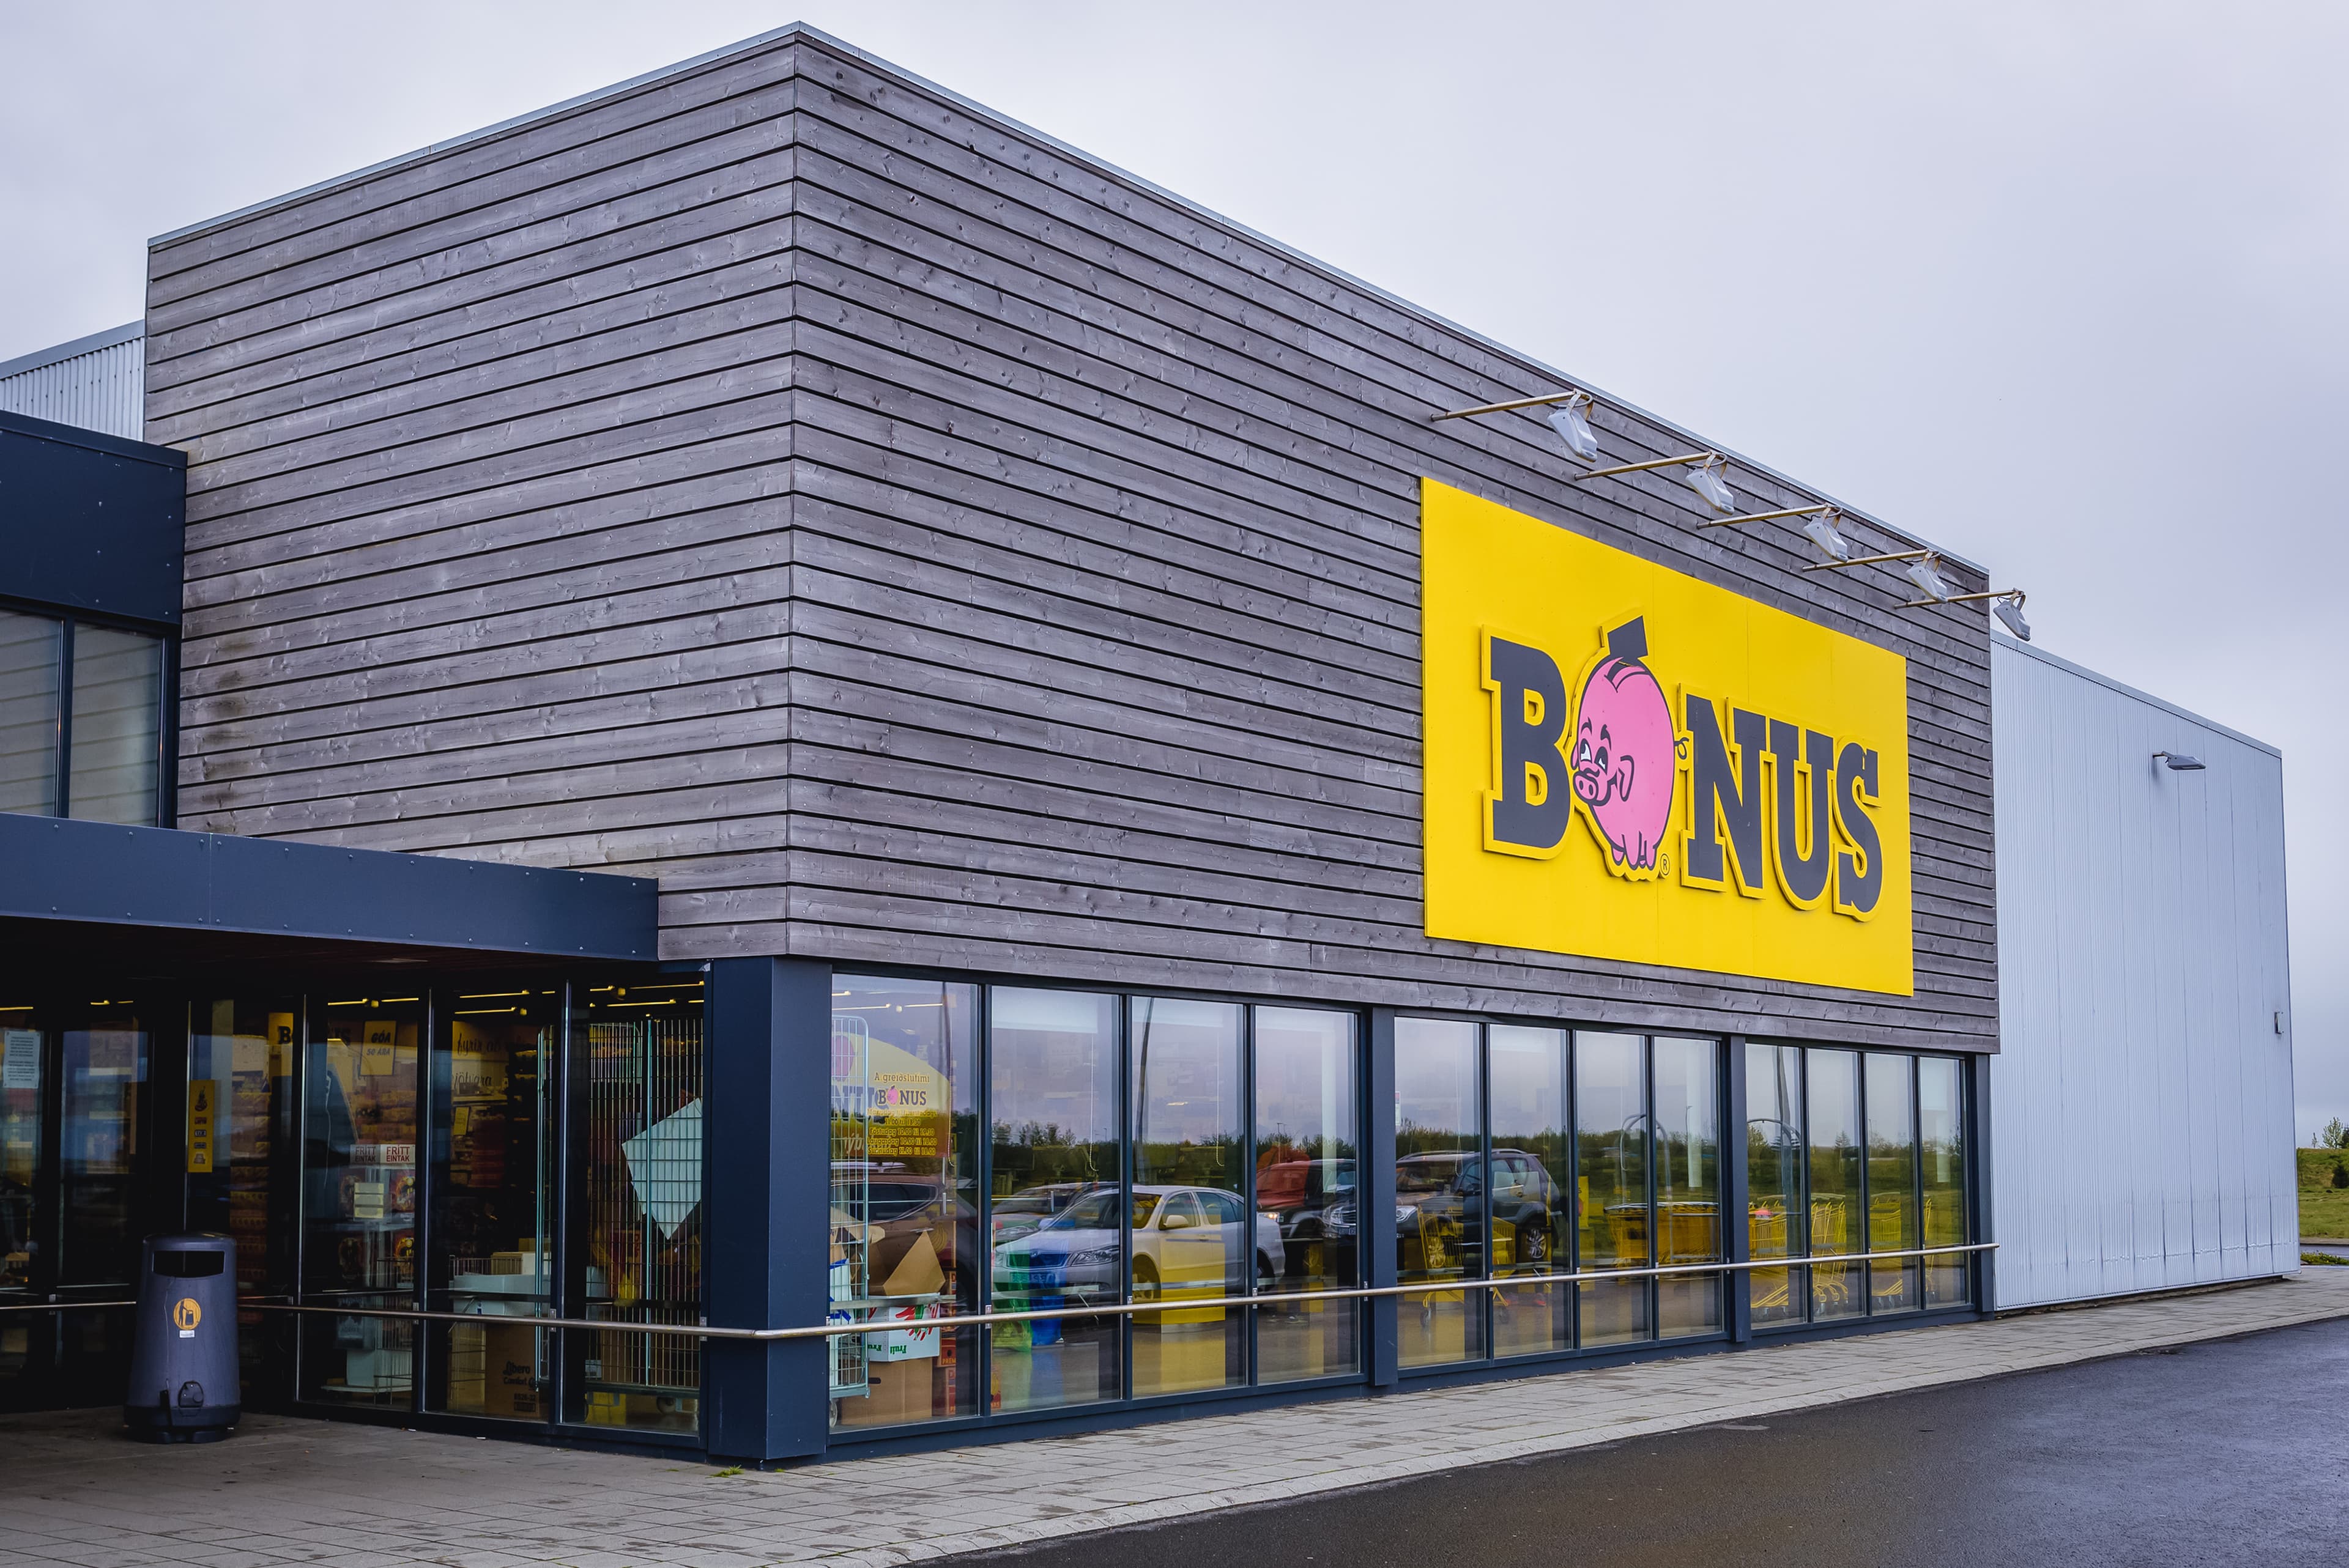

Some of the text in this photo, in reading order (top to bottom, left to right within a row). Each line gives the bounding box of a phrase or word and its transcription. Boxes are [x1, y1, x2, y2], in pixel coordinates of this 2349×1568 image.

[355, 1144, 376, 1155] FRÍTT
[387, 1144, 410, 1155] FRÍTT
[890, 1345, 907, 1355] Fruit
